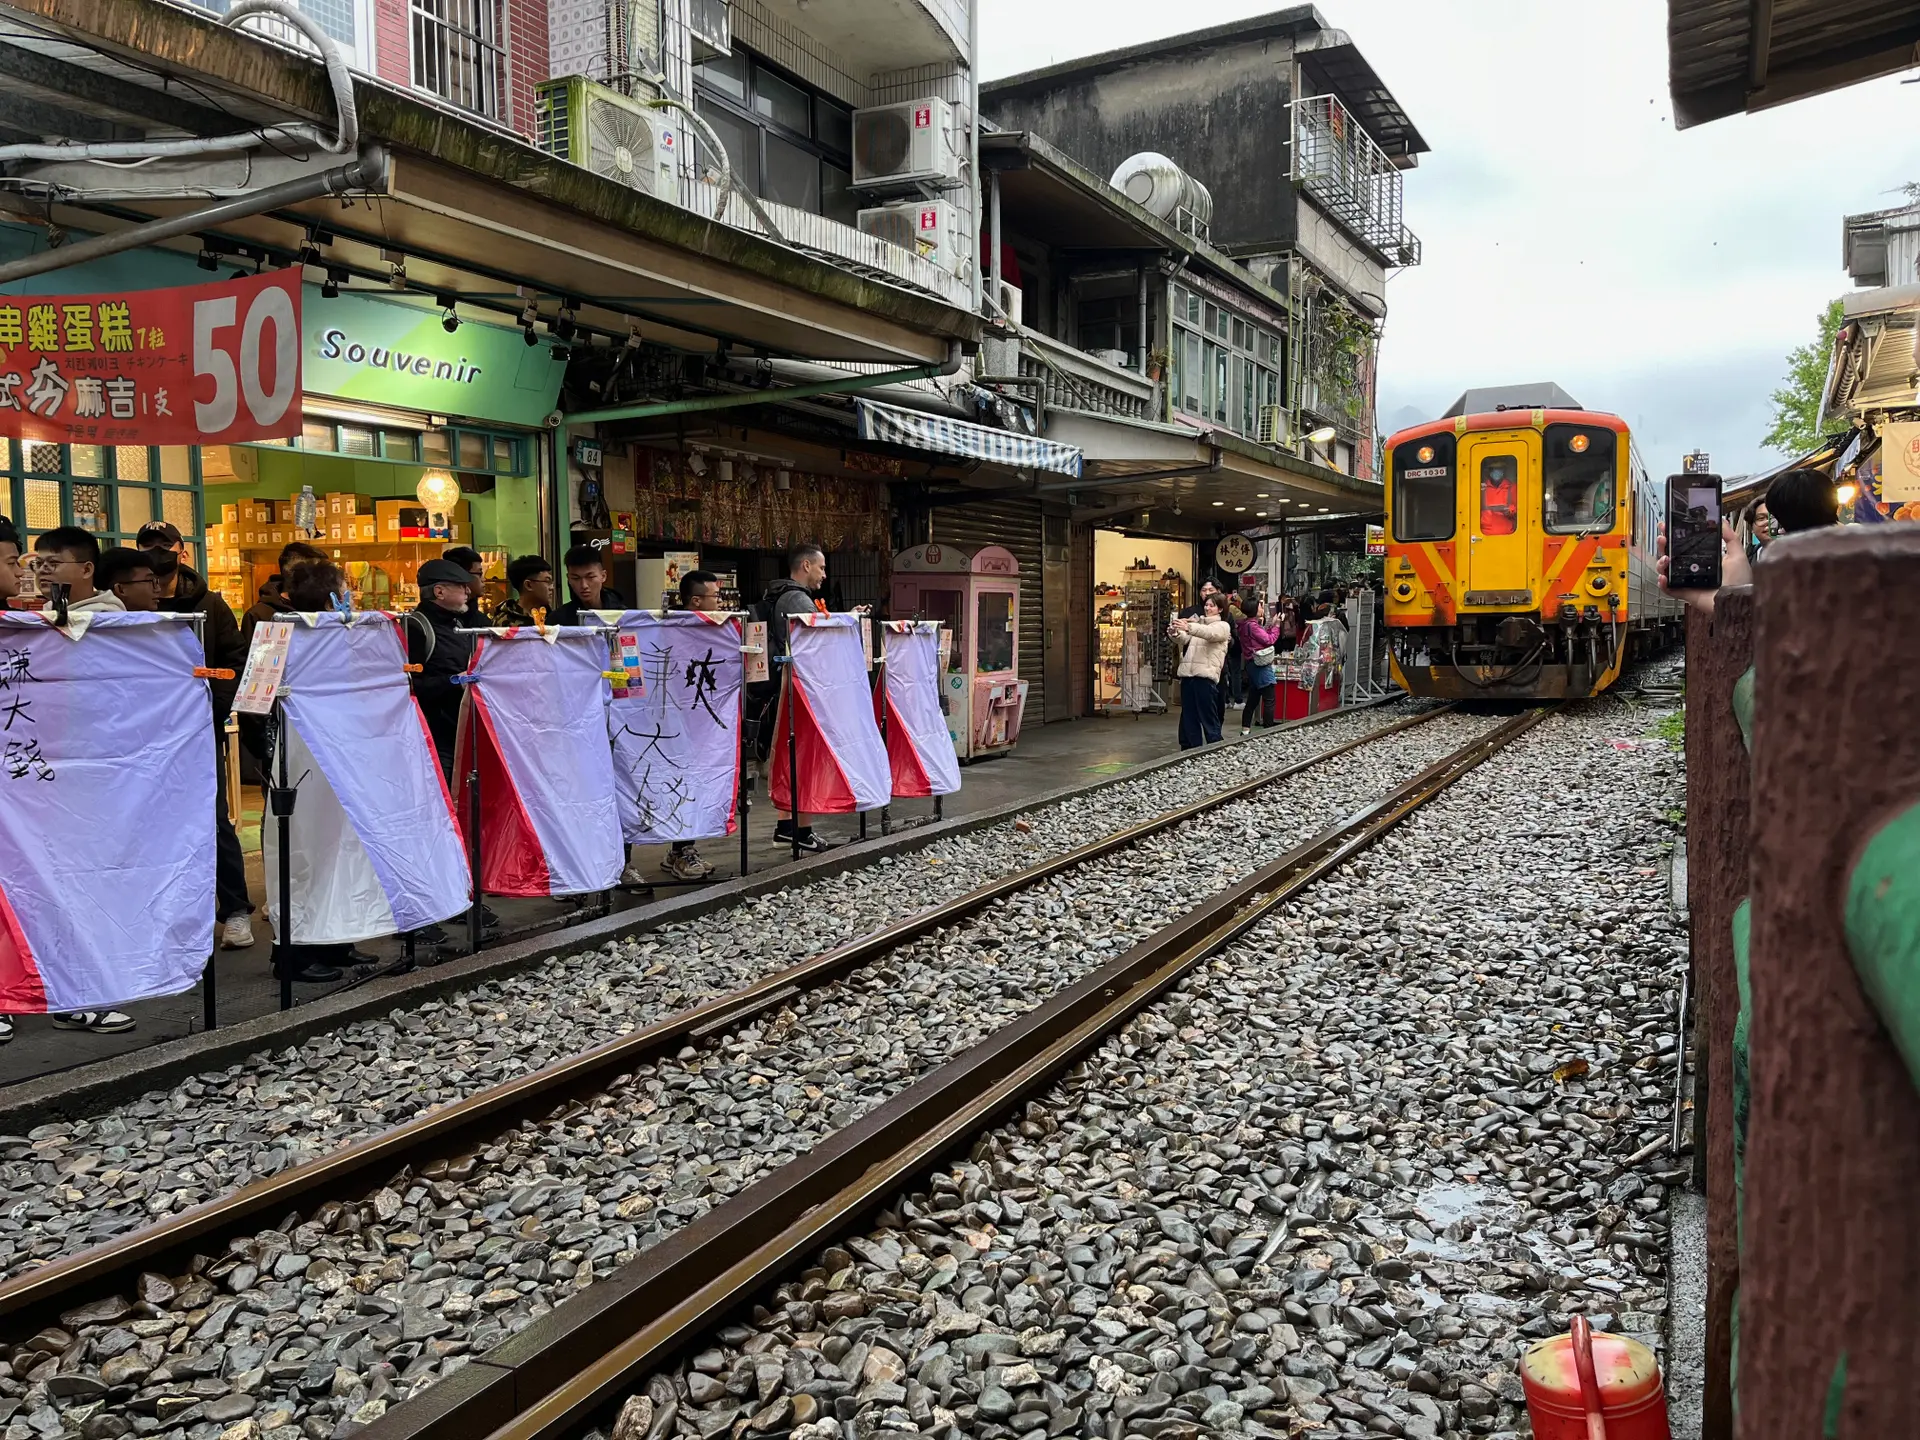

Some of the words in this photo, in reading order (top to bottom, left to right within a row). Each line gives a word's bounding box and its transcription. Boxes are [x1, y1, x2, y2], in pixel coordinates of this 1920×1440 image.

[0, 301, 134, 352] 串雞蛋糕
[137, 326, 166, 350] 7粒
[193, 285, 298, 434] 50
[321, 328, 482, 384] Souvenir
[586, 450, 598, 464] 84
[1407, 470, 1422, 478] DRC
